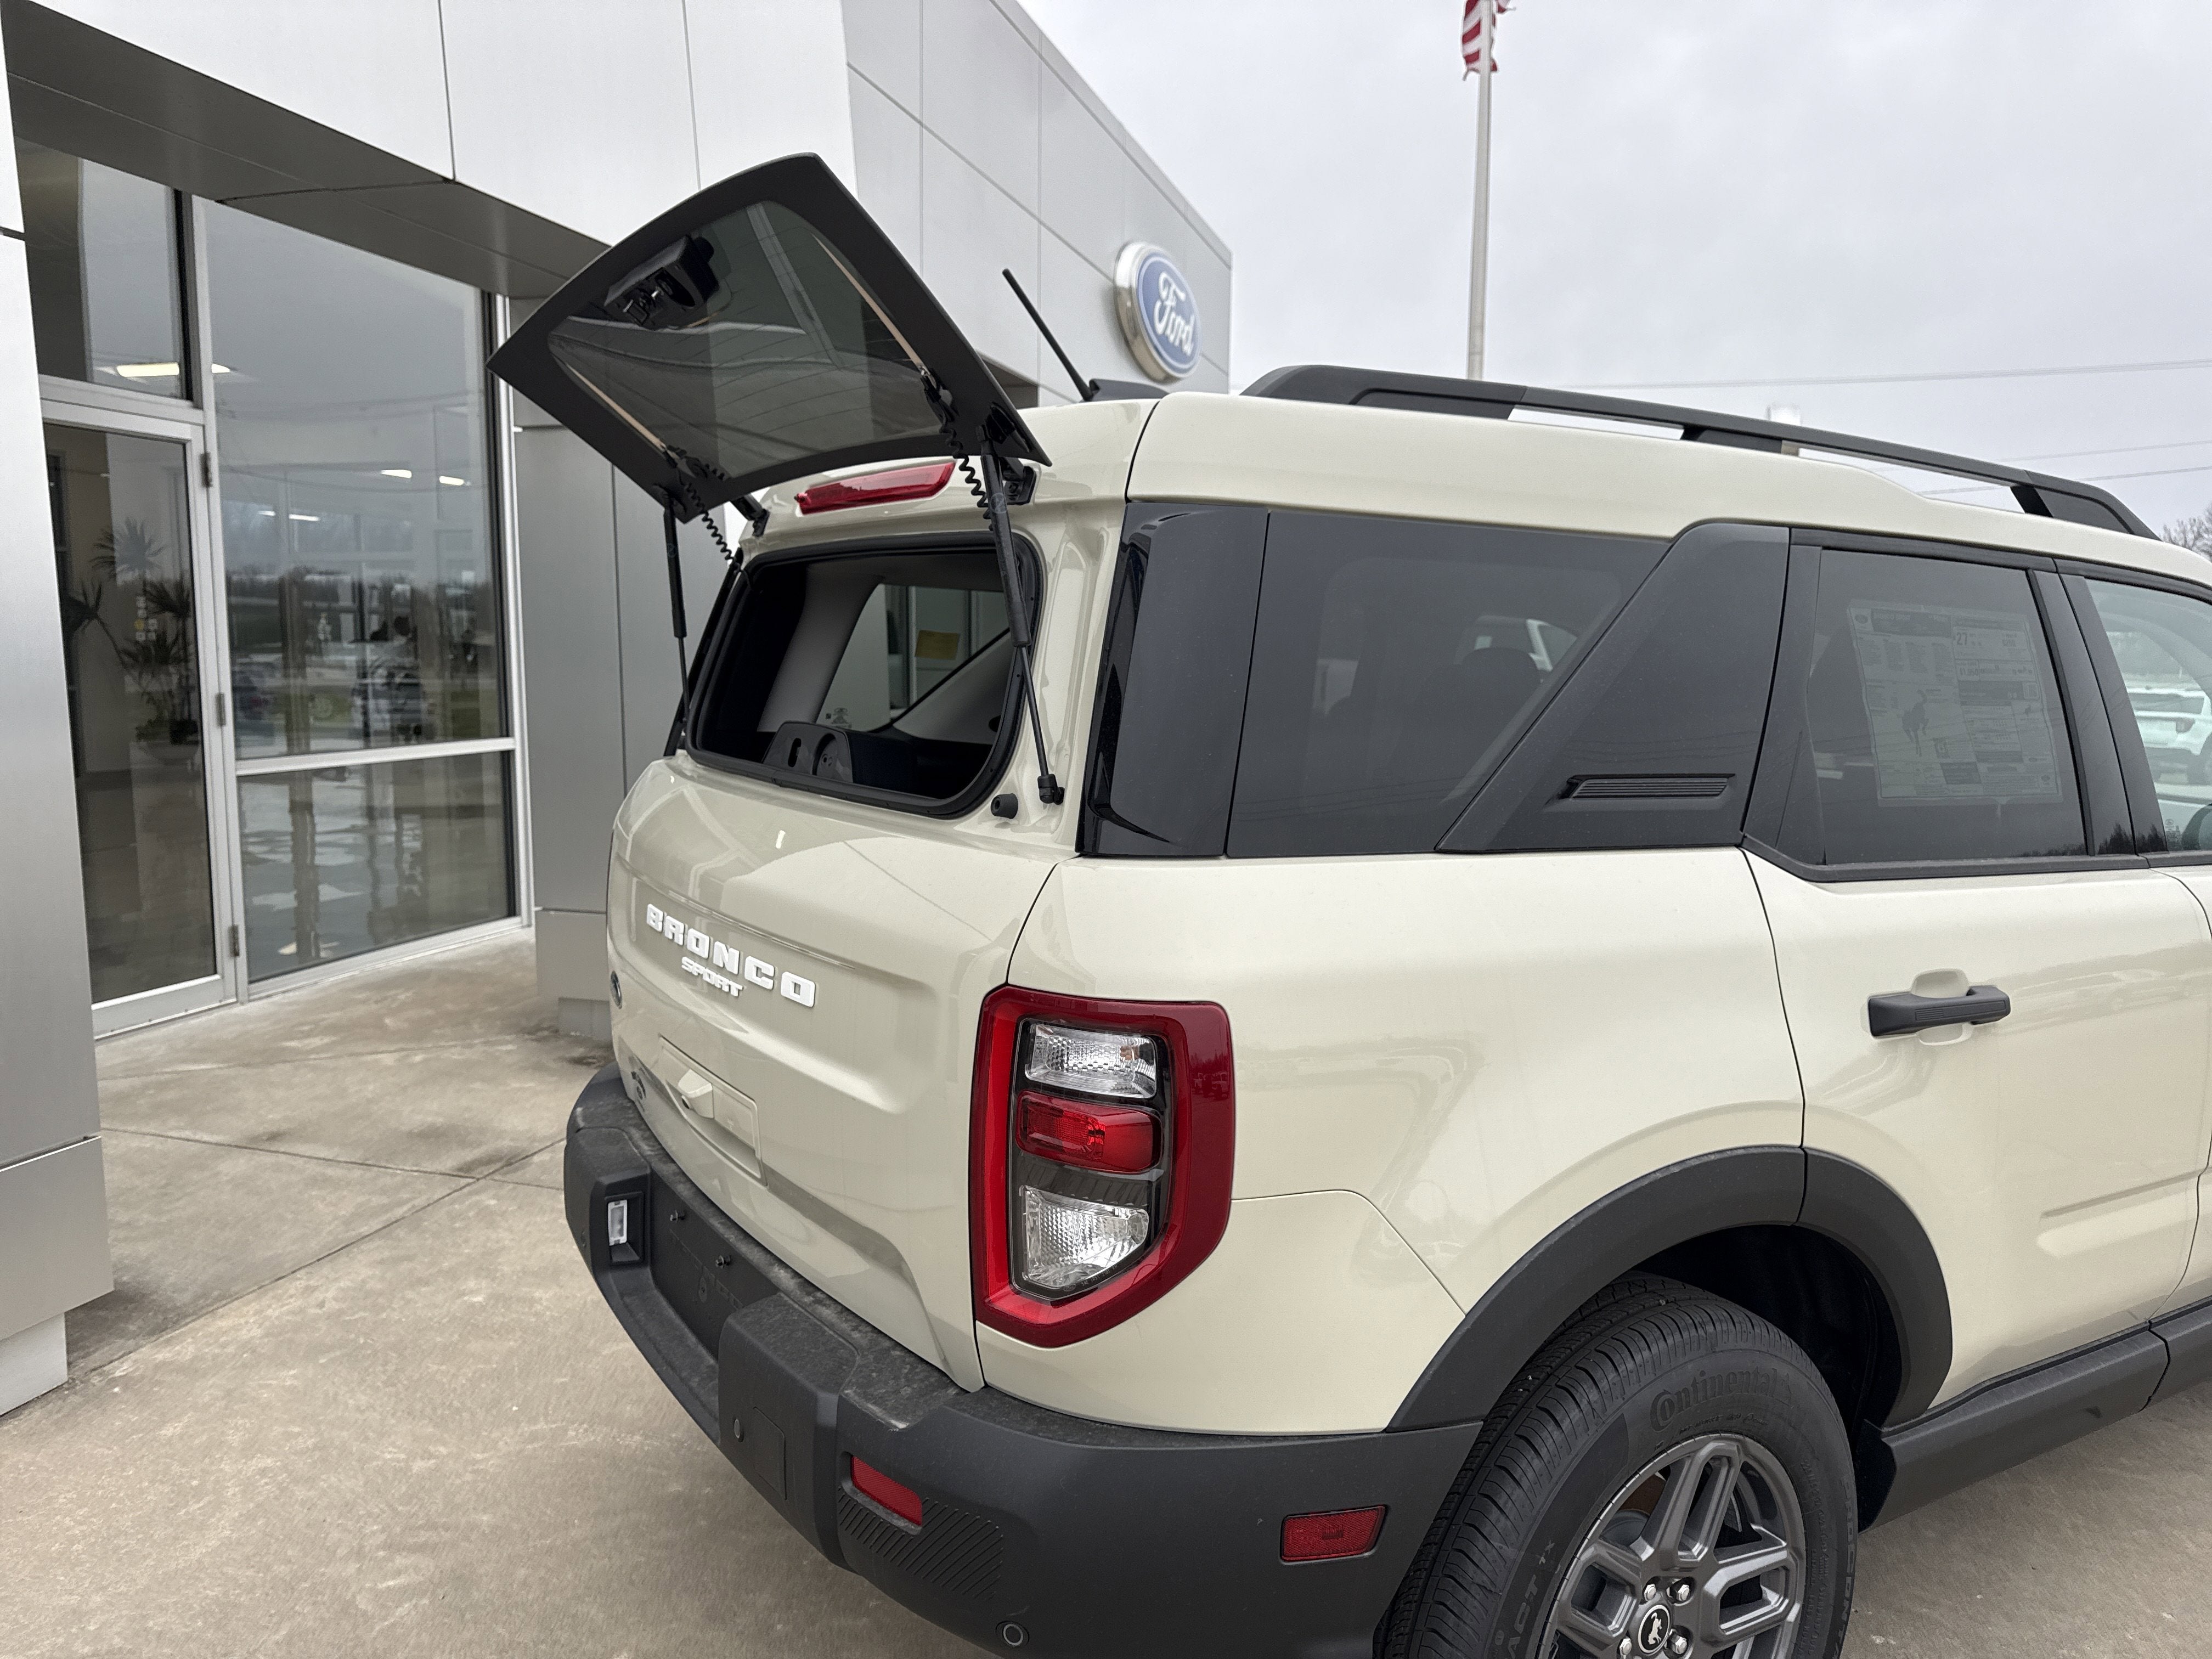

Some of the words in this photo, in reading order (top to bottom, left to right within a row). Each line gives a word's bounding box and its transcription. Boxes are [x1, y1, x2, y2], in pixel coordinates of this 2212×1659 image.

[1153, 272, 1195, 357] Ford
[646, 904, 816, 1008] BRONCO
[681, 956, 743, 997] SPORT
[1650, 1366, 1778, 1432] Continental
